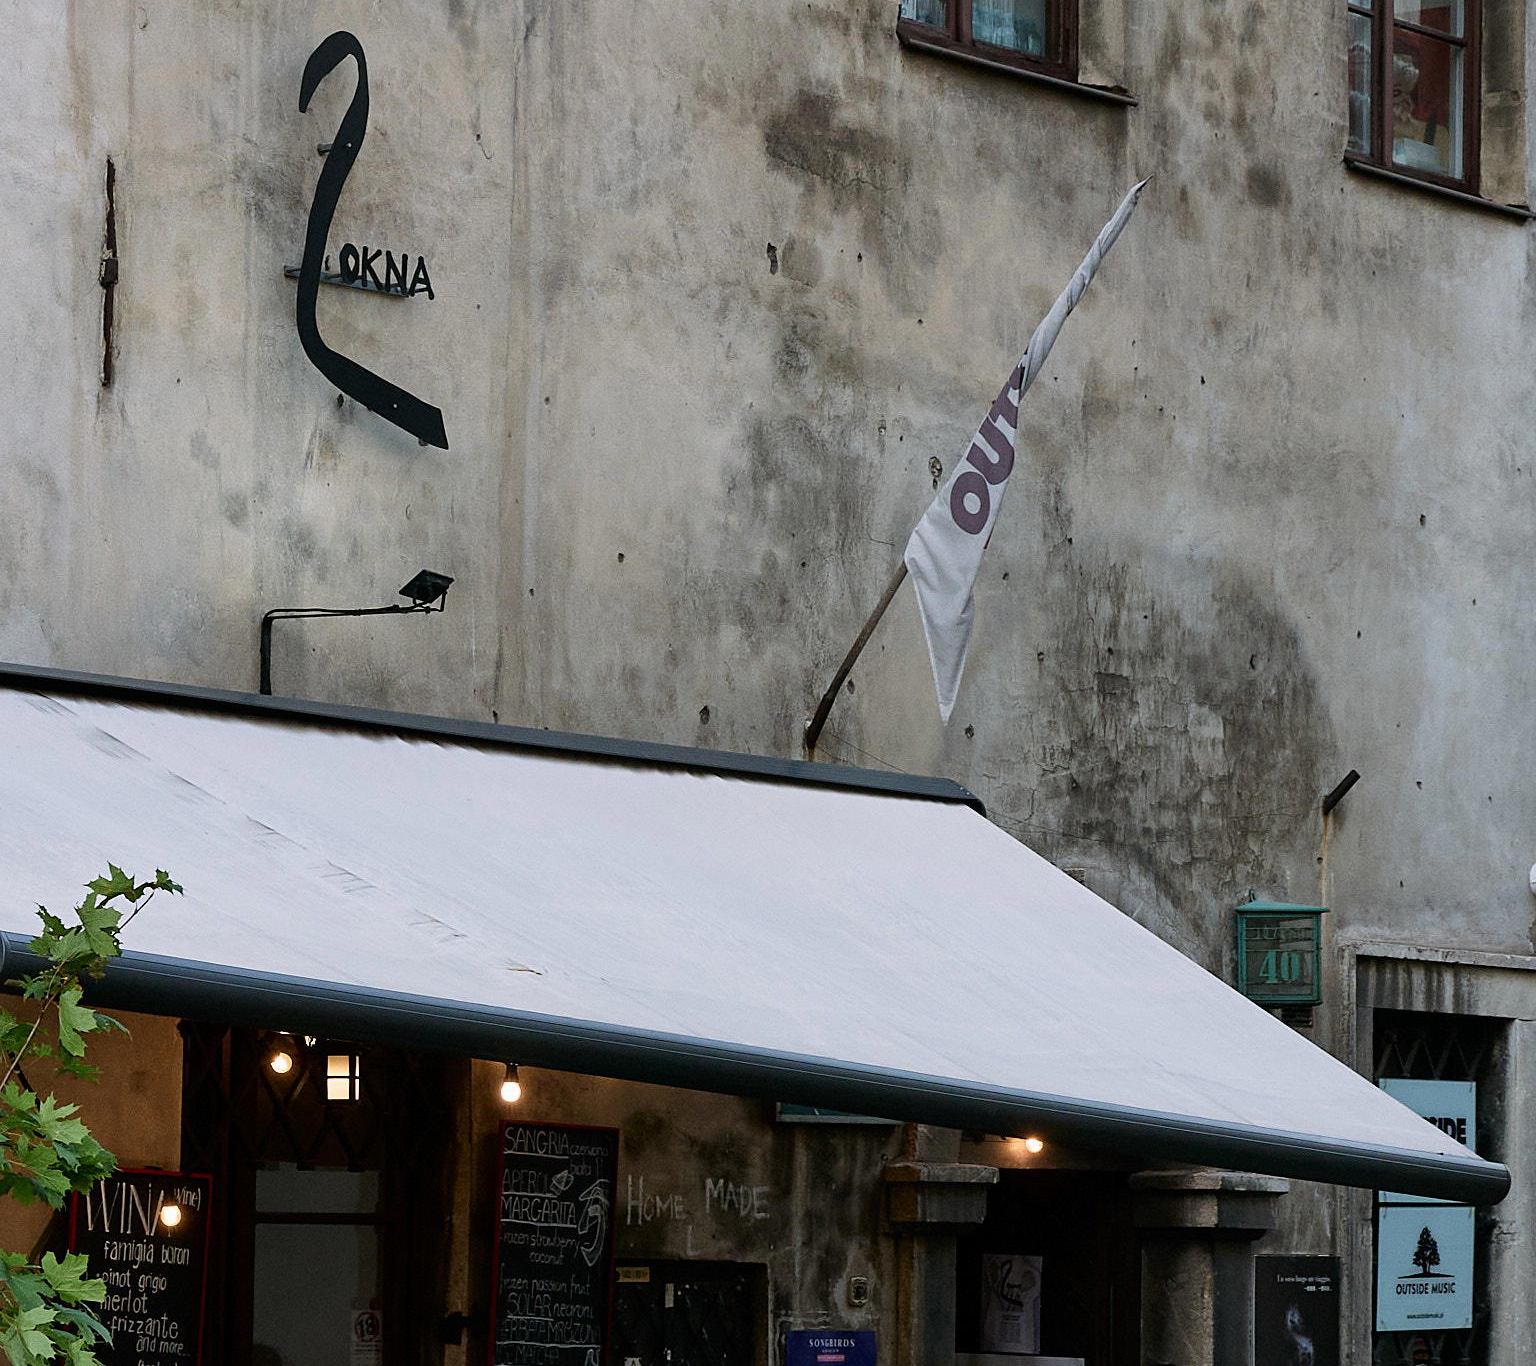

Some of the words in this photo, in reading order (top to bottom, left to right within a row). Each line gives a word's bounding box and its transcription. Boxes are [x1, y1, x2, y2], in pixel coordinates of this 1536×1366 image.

[339, 242, 435, 300] OKNA
[1259, 950, 1300, 984] 40
[504, 1127, 569, 1155] SANGRIA
[500, 1196, 577, 1225] MARGARITA
[705, 1178, 770, 1220] MADE
[138, 1272, 168, 1294] grigio
[1396, 1283, 1429, 1296] OUTSIDE
[1431, 1282, 1456, 1295] MUSIC
[111, 1313, 179, 1339] frizzante
[136, 1335, 156, 1353] and
[808, 1338, 857, 1349] SONGBIRDS
